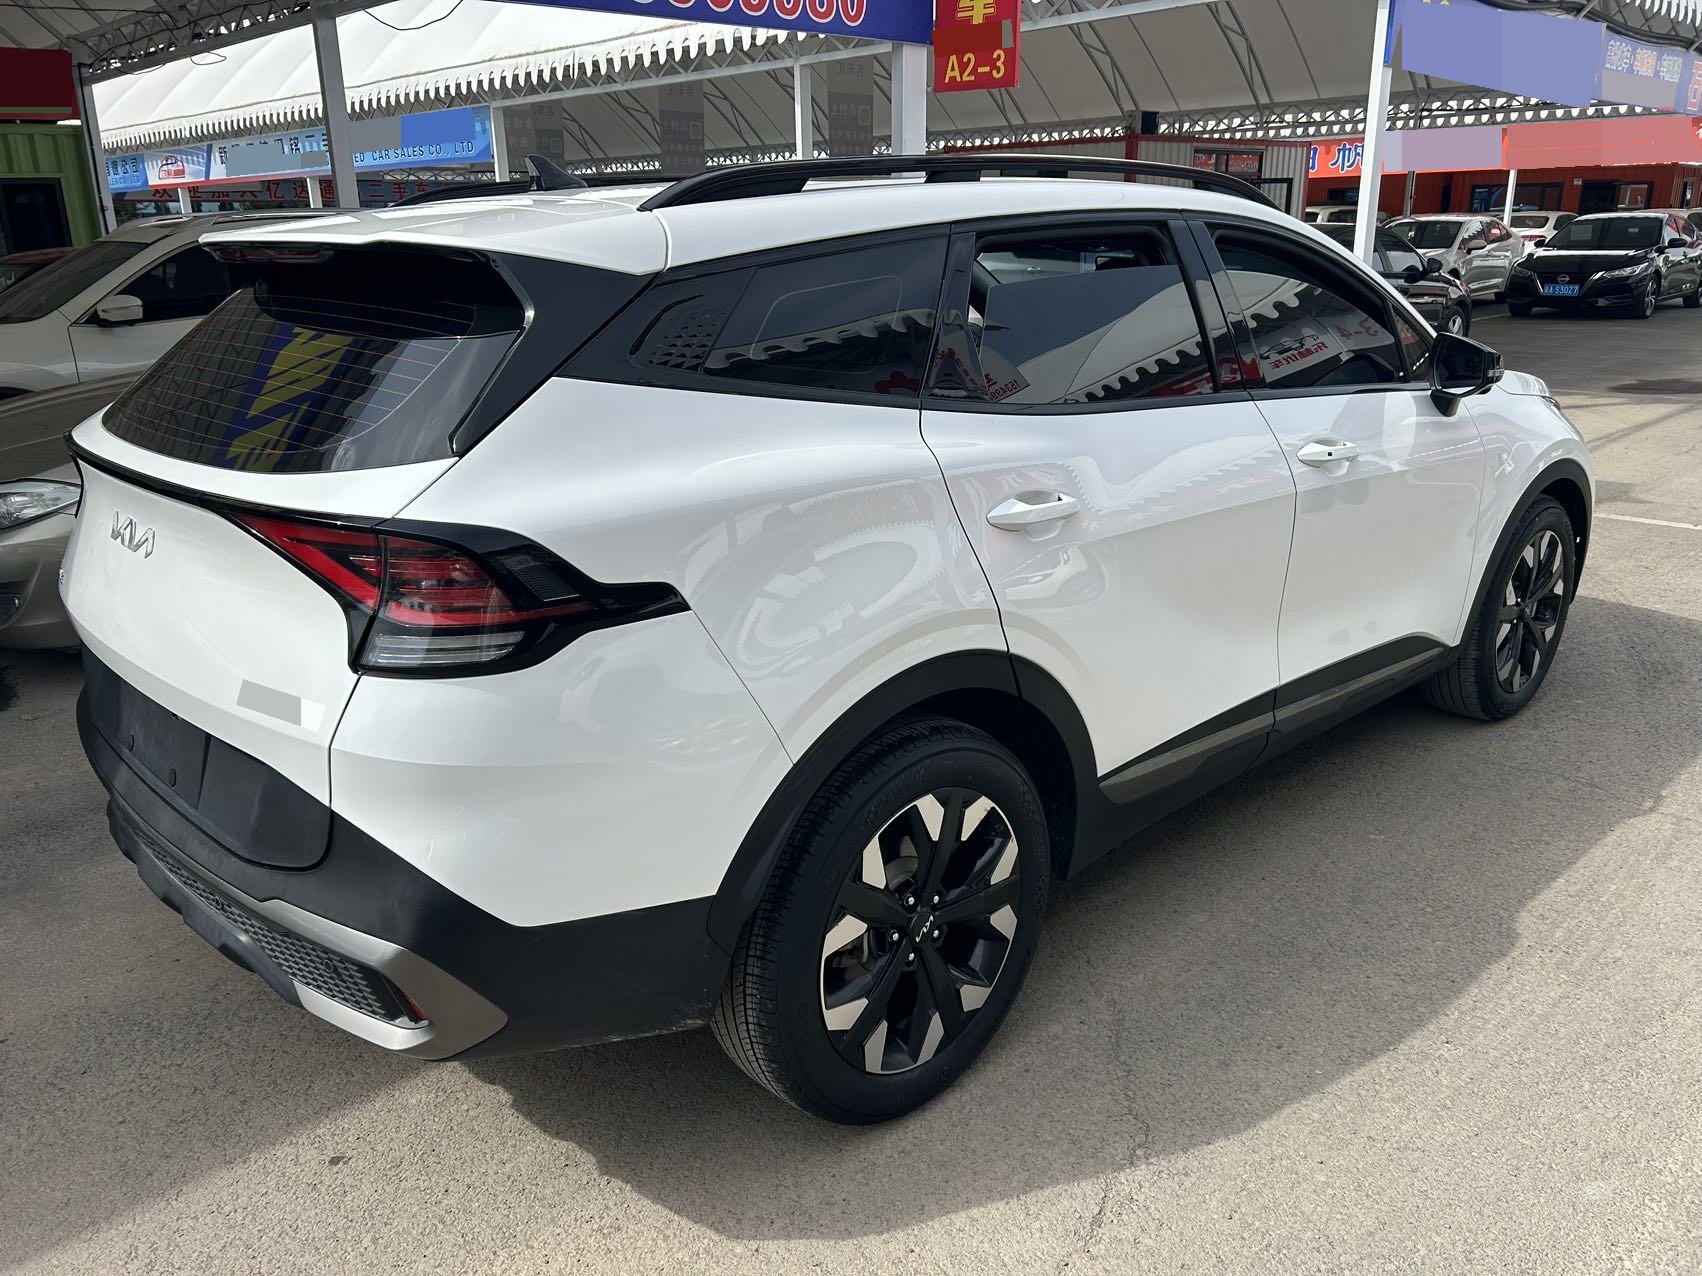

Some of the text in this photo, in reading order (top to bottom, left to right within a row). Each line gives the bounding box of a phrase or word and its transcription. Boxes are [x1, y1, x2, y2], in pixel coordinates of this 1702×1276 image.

[944, 49, 1005, 83] A2-3
[371, 148, 391, 162] CAR
[394, 145, 425, 159] SALES
[454, 140, 475, 154] LTD
